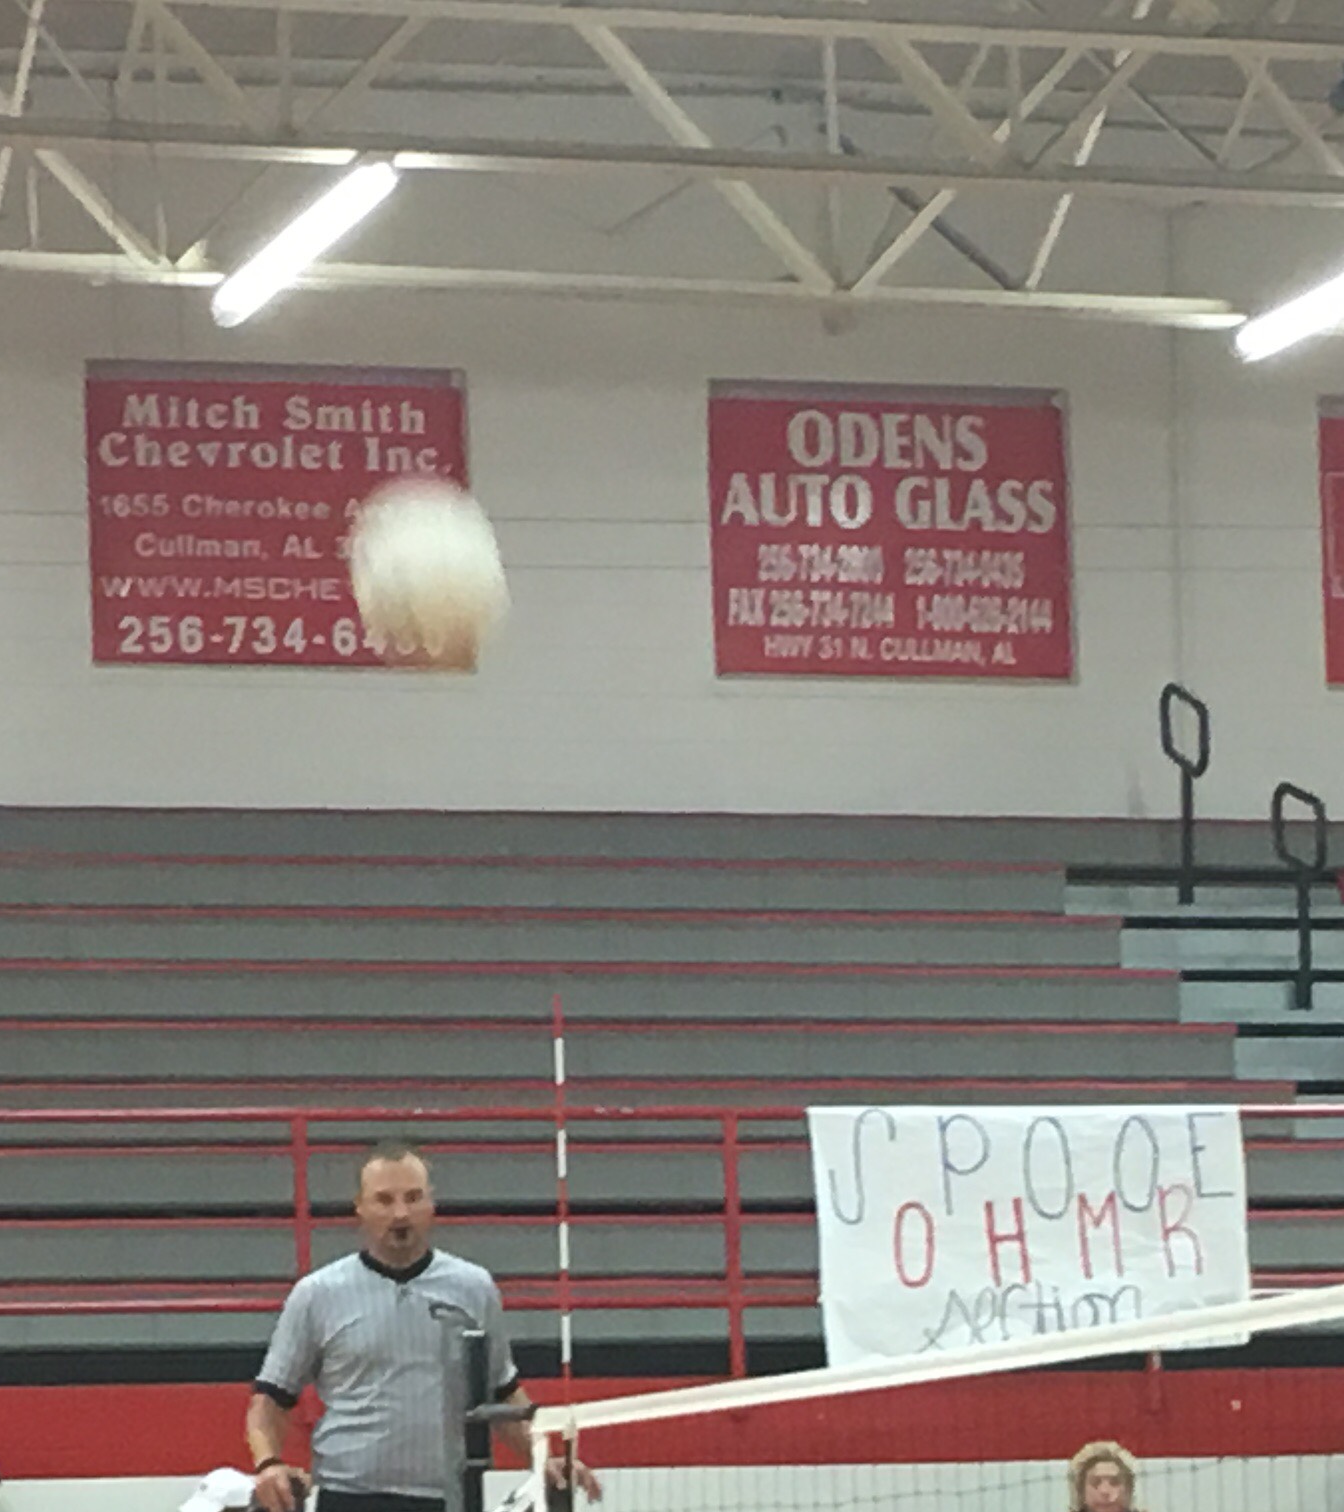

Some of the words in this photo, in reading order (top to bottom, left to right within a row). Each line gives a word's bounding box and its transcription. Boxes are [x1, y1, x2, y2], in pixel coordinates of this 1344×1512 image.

[121, 395, 261, 430] Mitch
[283, 395, 426, 434] Smith
[98, 433, 345, 471] Chevrolet
[365, 436, 454, 474] Inc.
[786, 409, 989, 472] ODENS
[101, 494, 170, 518] 1655
[181, 495, 331, 520] Cherokee
[721, 472, 874, 529] AUTO
[895, 476, 1056, 533] GLASS
[282, 536, 323, 559] AL
[102, 576, 353, 601] WWW.MSCHE
[763, 634, 812, 659] HWY
